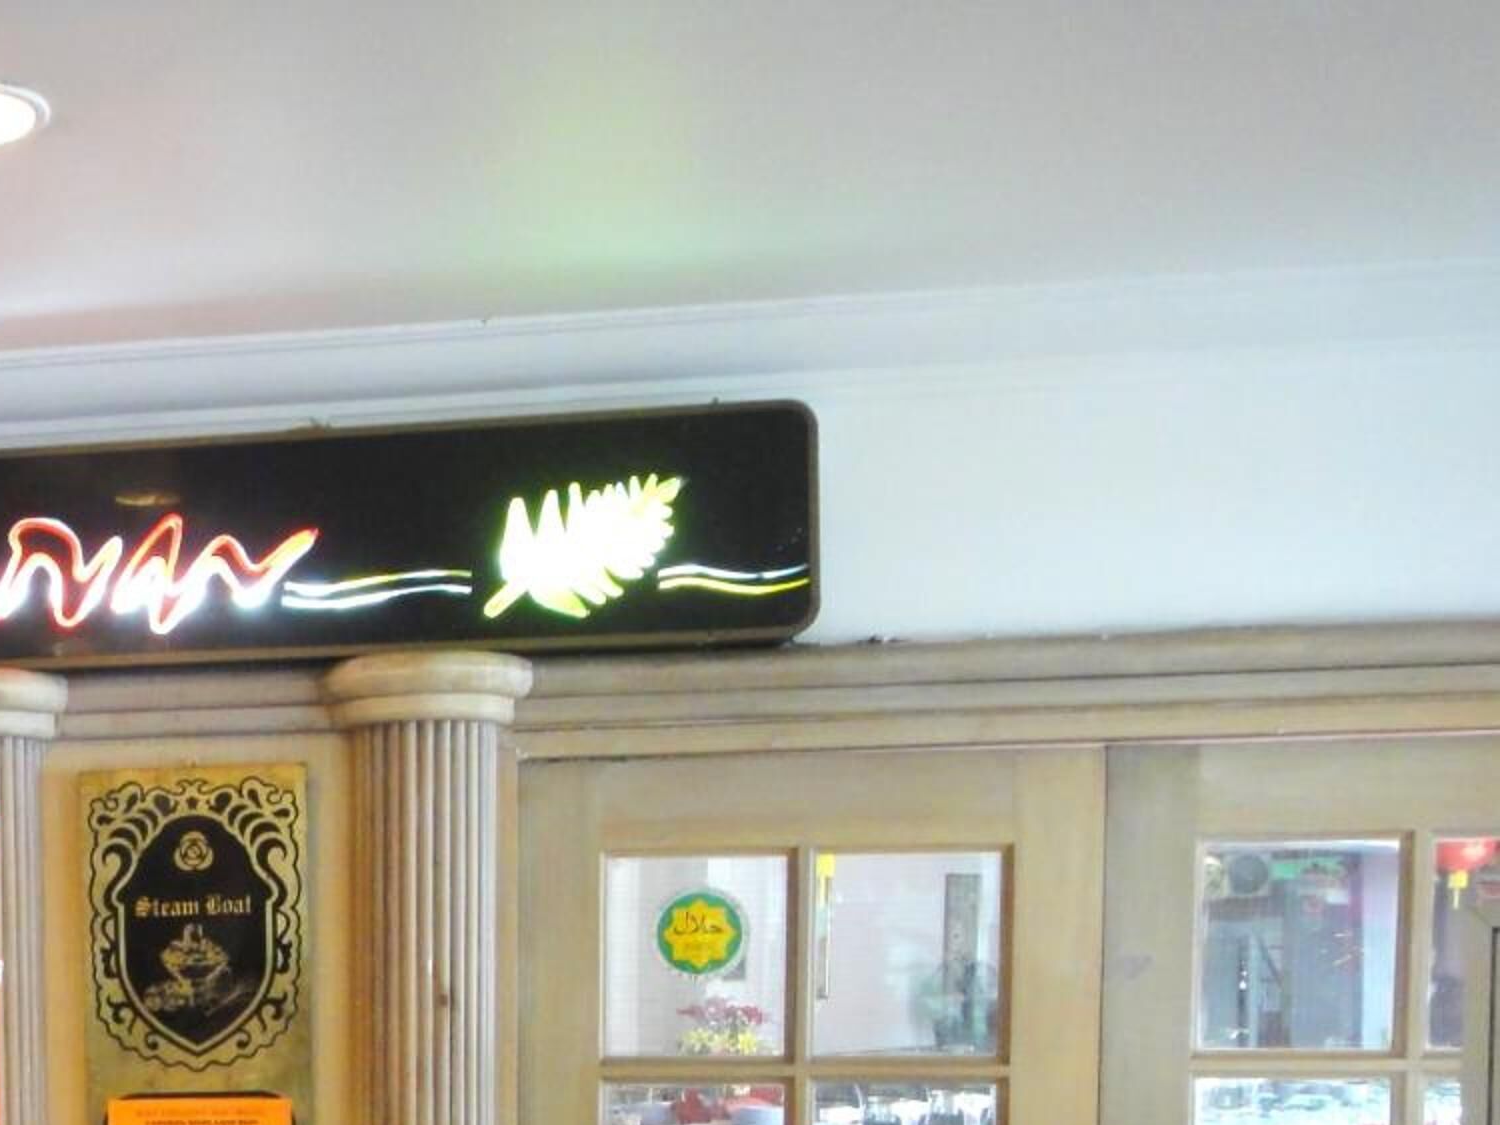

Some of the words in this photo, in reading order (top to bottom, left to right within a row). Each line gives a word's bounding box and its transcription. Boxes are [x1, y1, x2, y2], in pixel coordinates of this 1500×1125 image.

[135, 895, 199, 918] Steam
[206, 894, 251, 916] Boat
[673, 911, 725, 936] حلال
